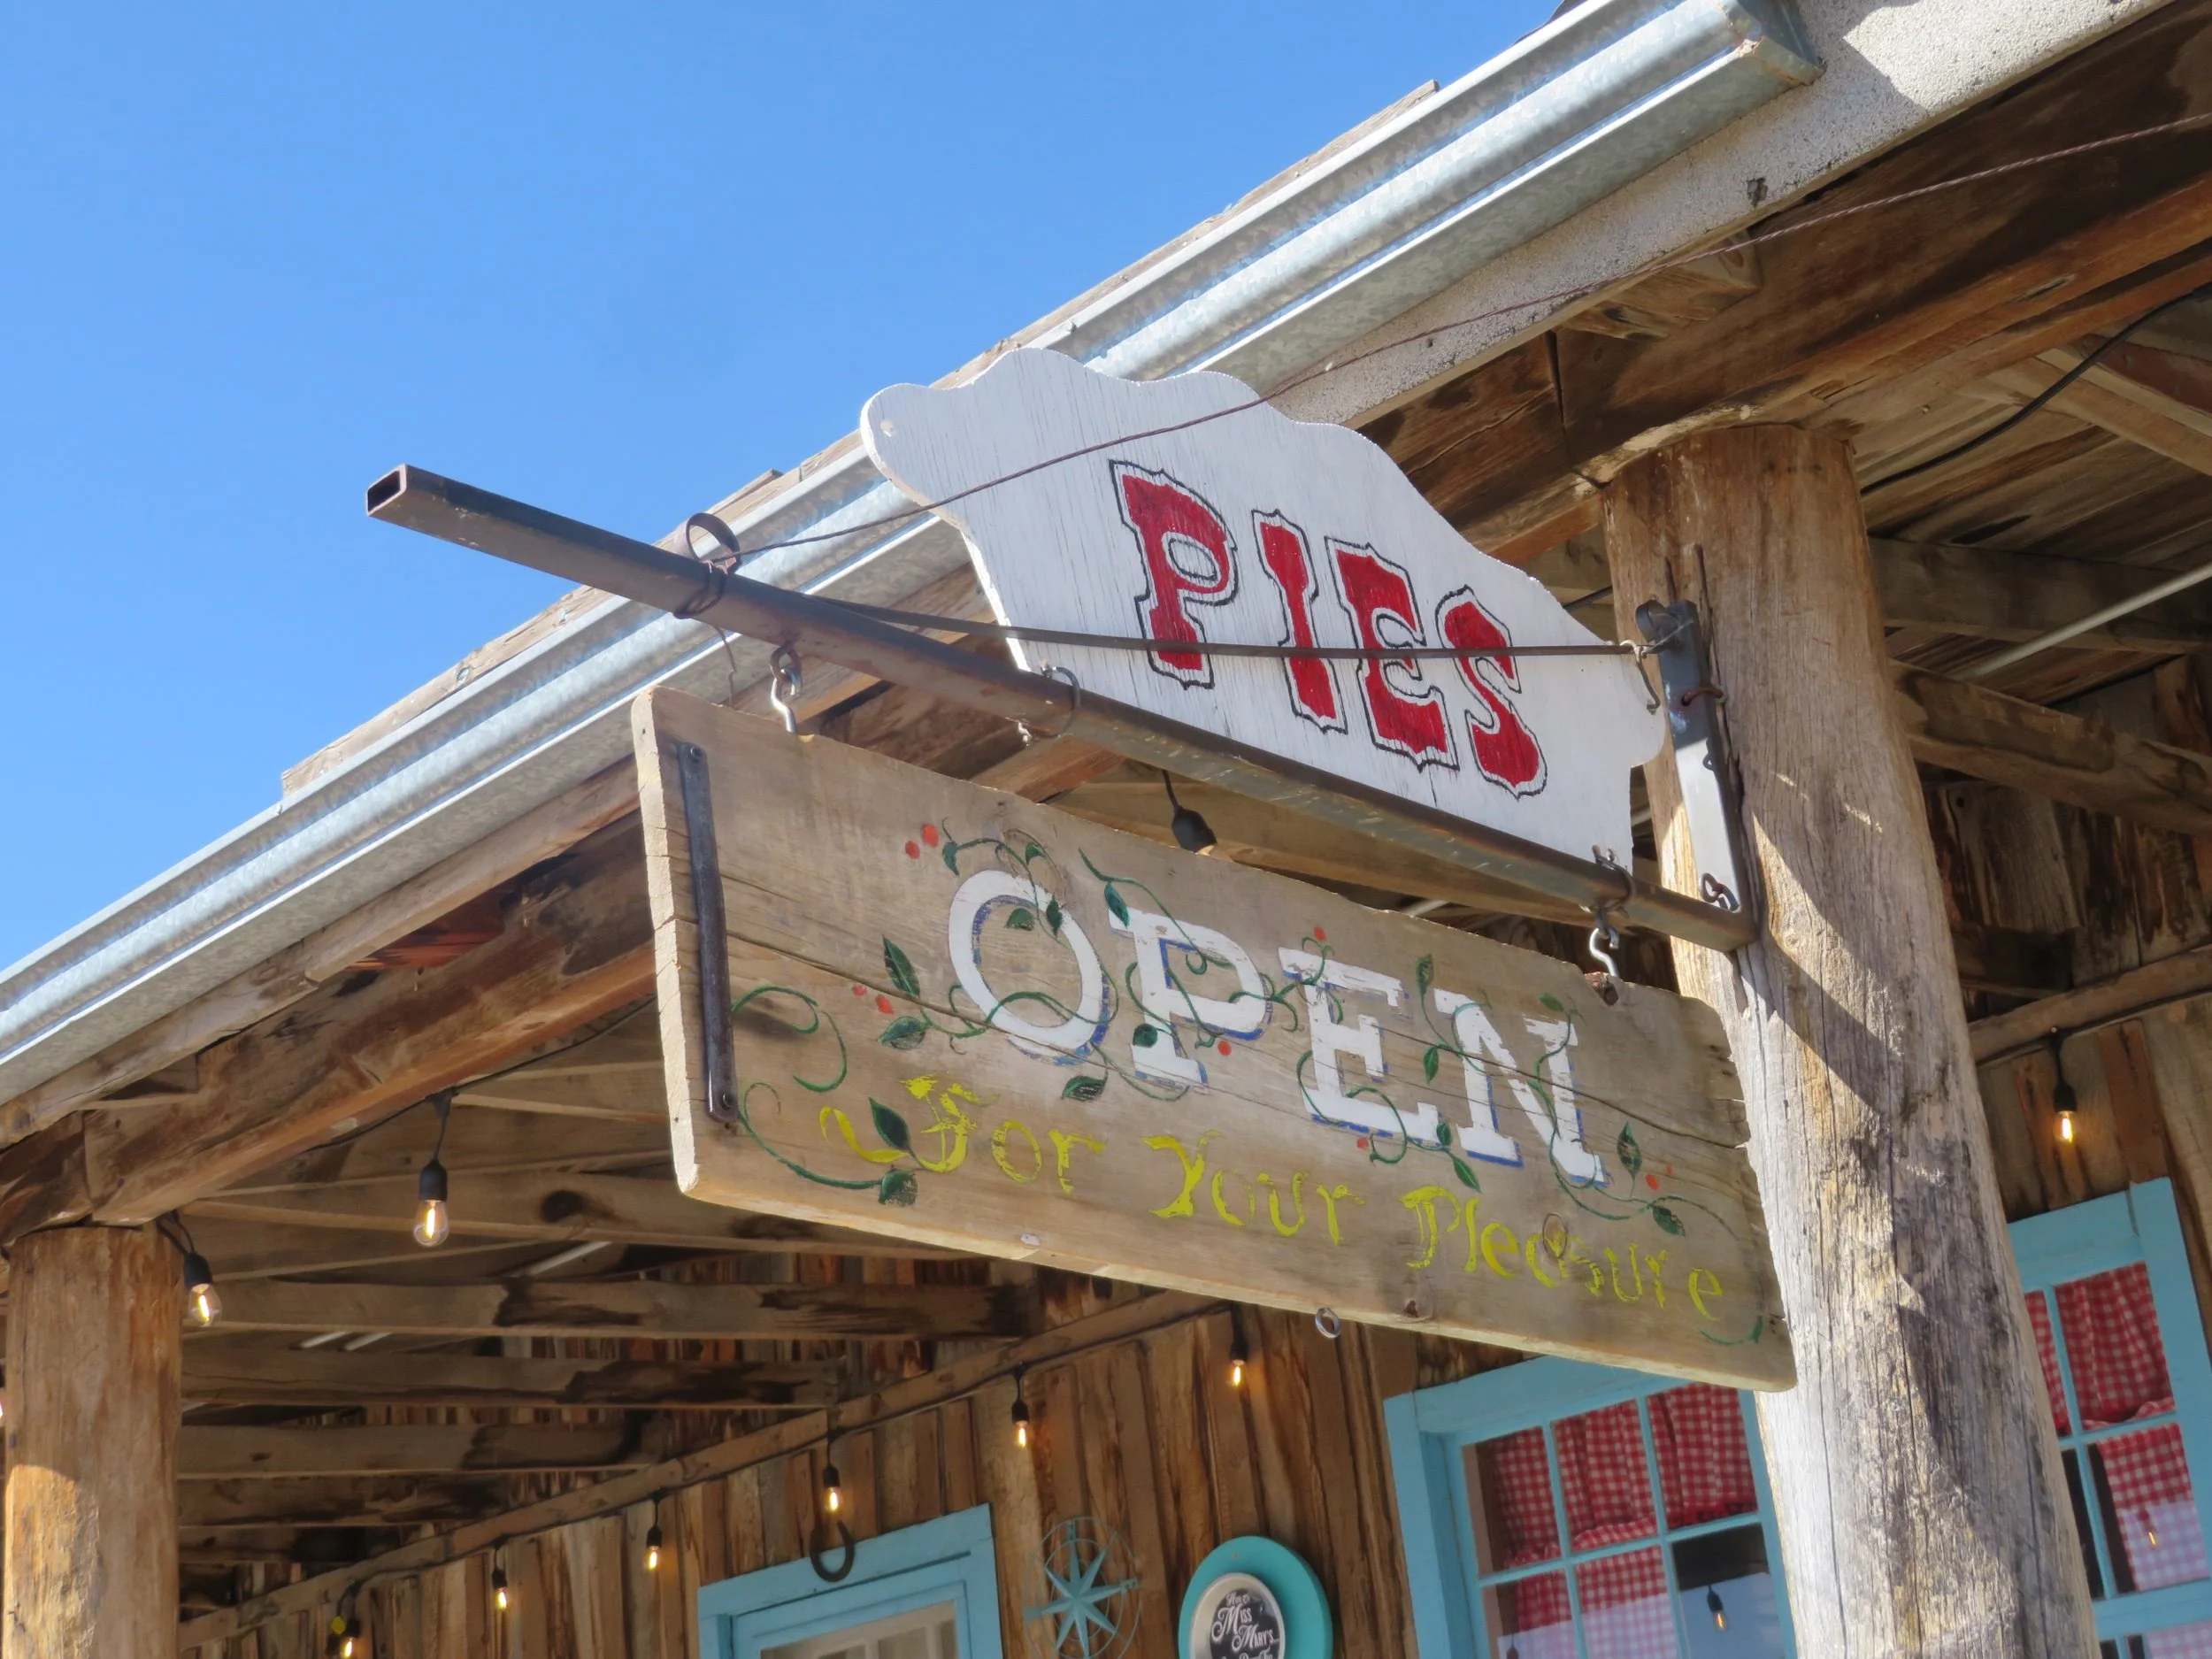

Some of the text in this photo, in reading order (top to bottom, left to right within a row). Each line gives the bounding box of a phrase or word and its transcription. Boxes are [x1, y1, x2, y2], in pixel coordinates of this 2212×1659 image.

[1109, 458, 1548, 801] PIES
[819, 1073, 1106, 1194] For
[1141, 1129, 1367, 1246] Your
[948, 869, 1609, 1188] OPEN
